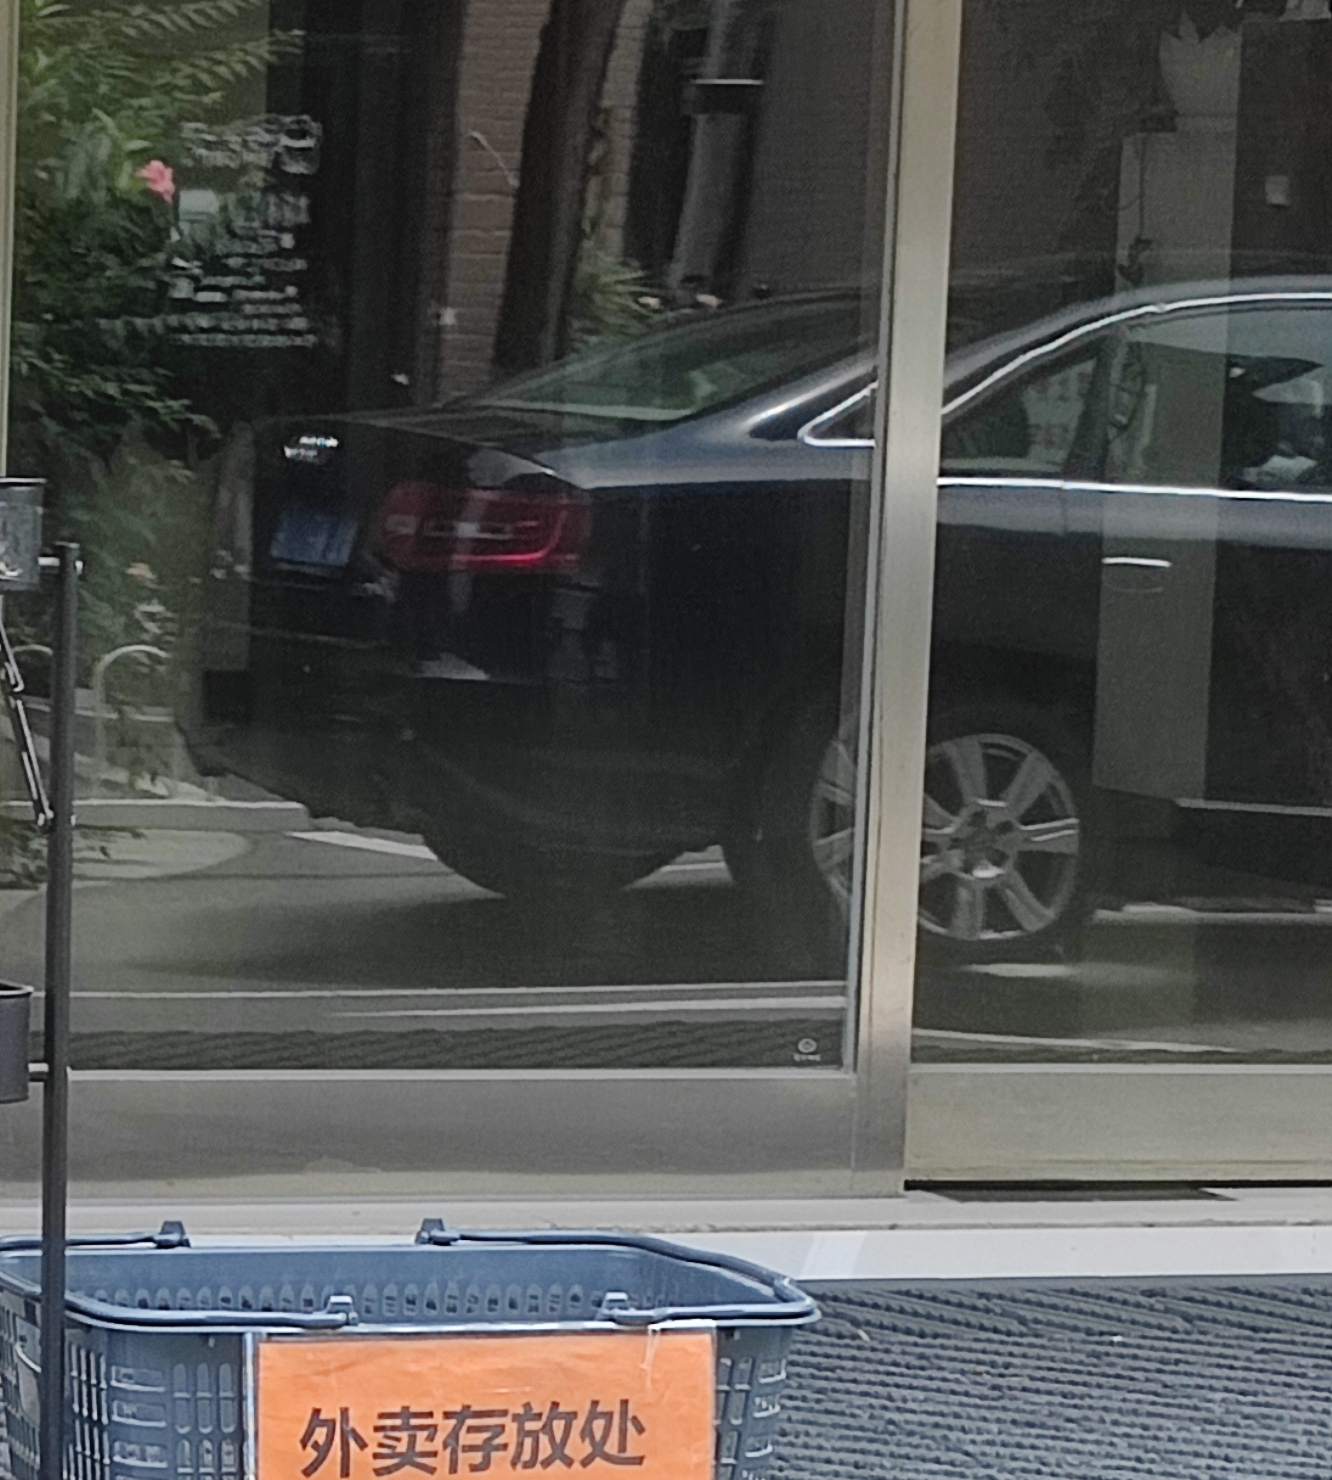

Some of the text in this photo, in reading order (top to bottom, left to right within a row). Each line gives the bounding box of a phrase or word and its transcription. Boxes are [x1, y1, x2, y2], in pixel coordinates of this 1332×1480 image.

[299, 1399, 646, 1479] 外卖存放处
